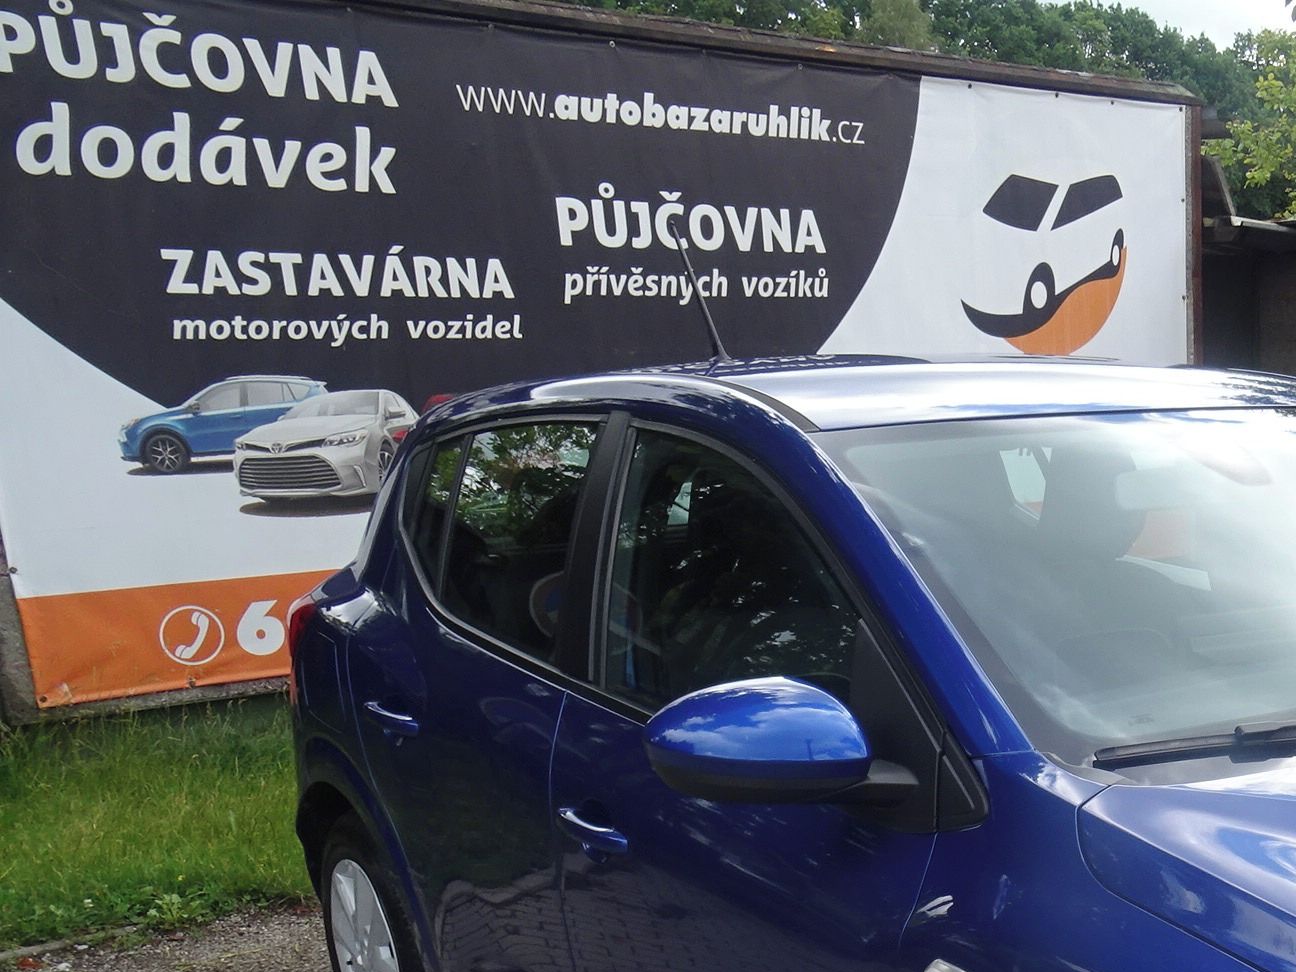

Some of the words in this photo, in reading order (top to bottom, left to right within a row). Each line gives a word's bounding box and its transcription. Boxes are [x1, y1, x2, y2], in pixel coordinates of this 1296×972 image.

[0, 0, 399, 108] PŮJČOVNA
[455, 84, 866, 145] www.autobazaruhlik.cz
[15, 101, 397, 194] dodávek
[554, 182, 827, 254] PŮJČOVNA
[160, 245, 515, 299] ZASTAVÁRNA
[564, 265, 728, 305] přívěsných
[741, 267, 829, 298] vozíků
[173, 313, 389, 347] motorových
[406, 313, 523, 339] vozidel
[236, 599, 286, 656] 6
